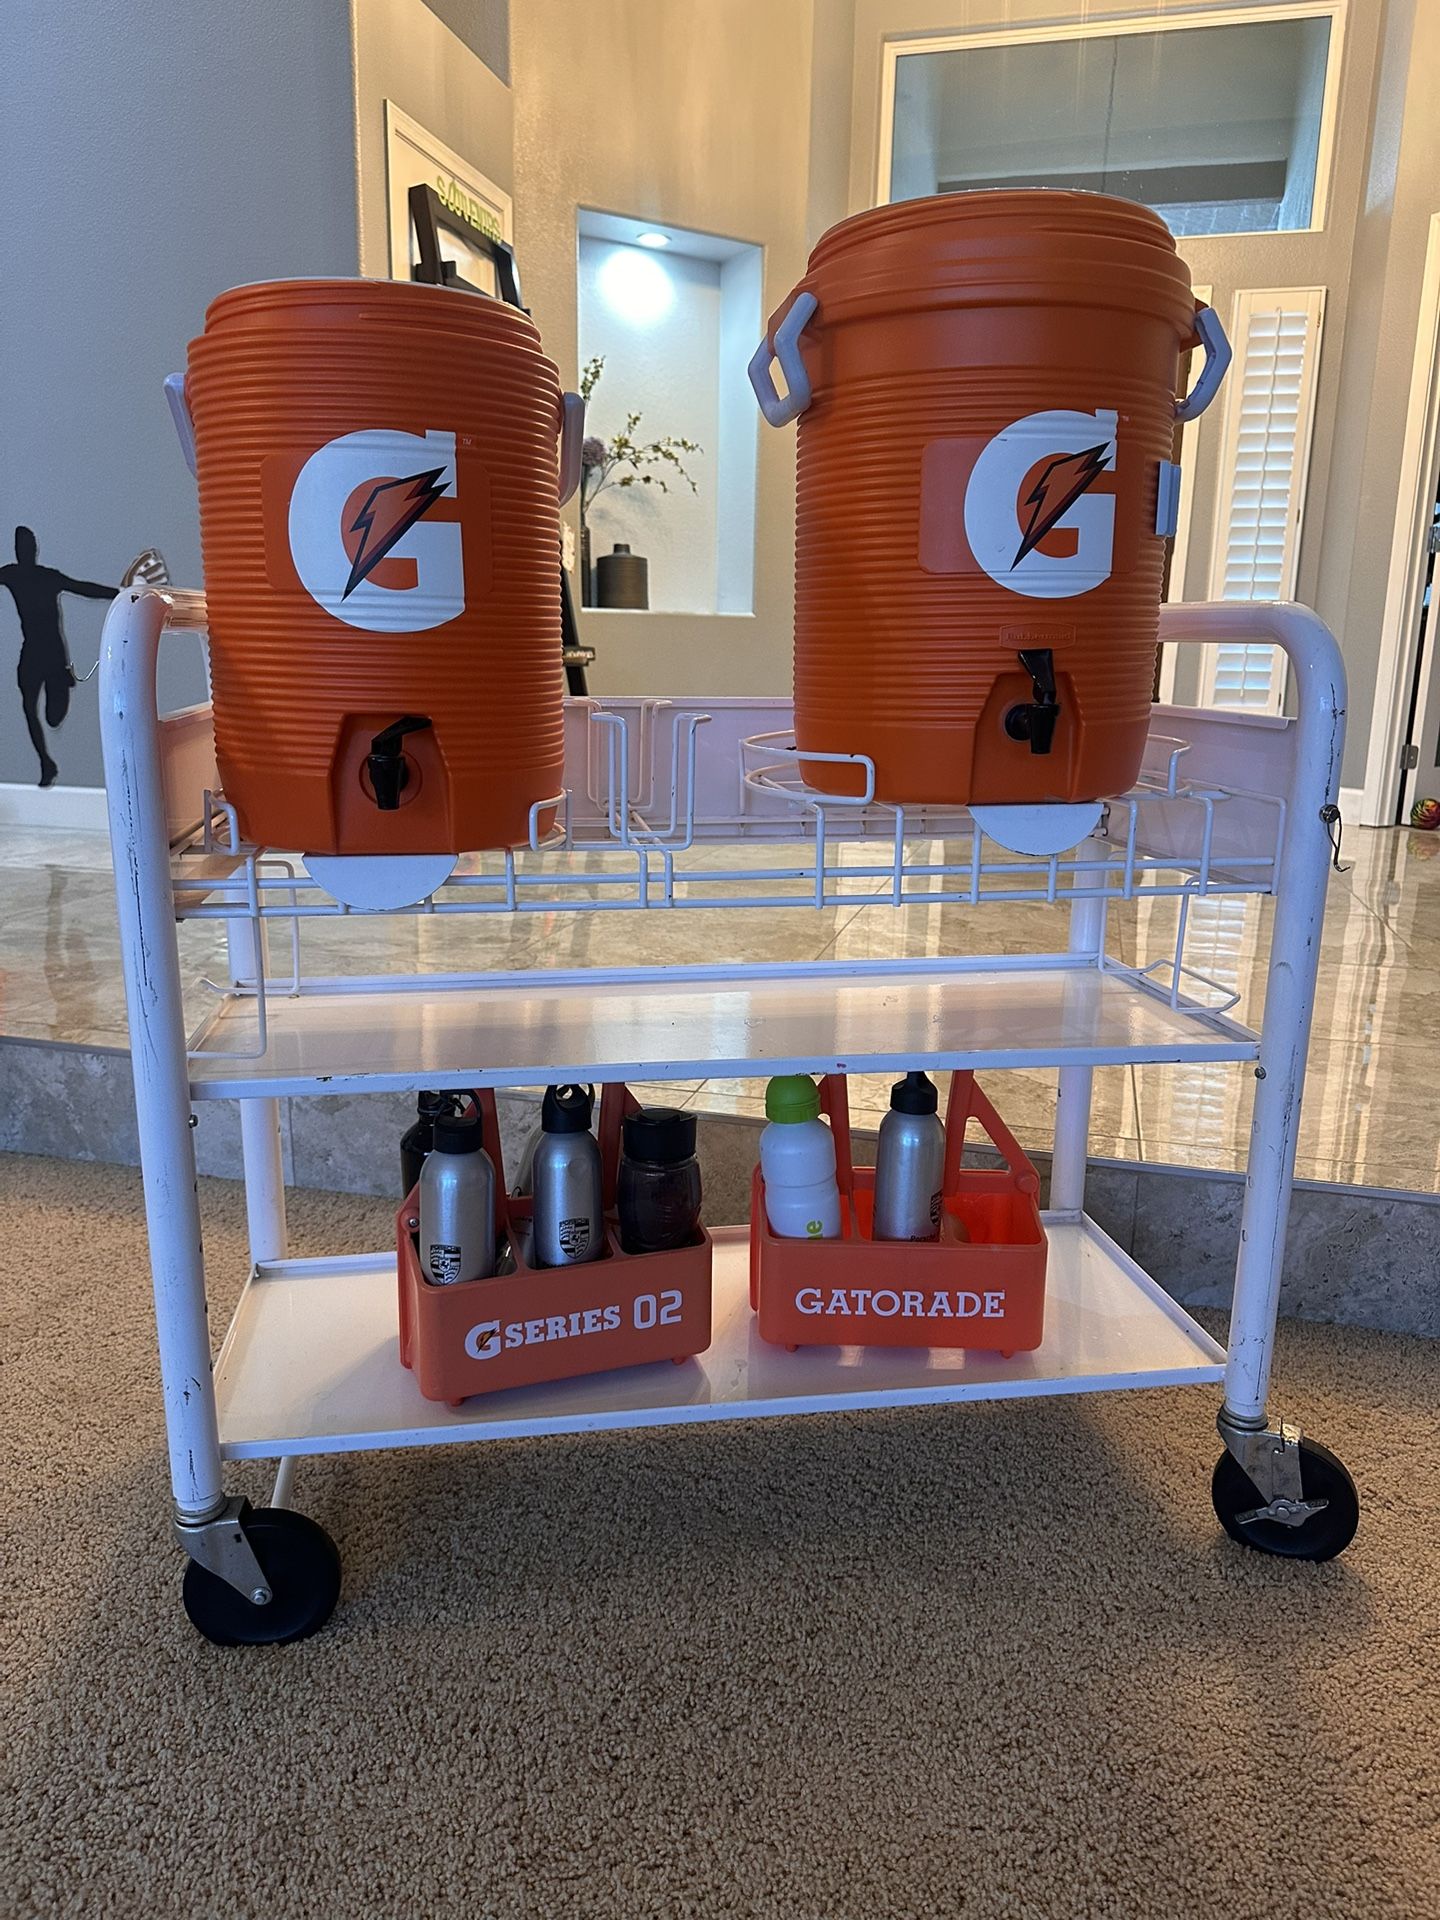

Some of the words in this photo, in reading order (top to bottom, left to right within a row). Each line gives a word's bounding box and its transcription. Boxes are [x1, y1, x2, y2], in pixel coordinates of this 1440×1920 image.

[288, 428, 466, 634] G
[963, 408, 1119, 598] G
[504, 1304, 621, 1349] SERIES
[633, 1289, 683, 1330] 02
[794, 1287, 1006, 1318] GATORADE
